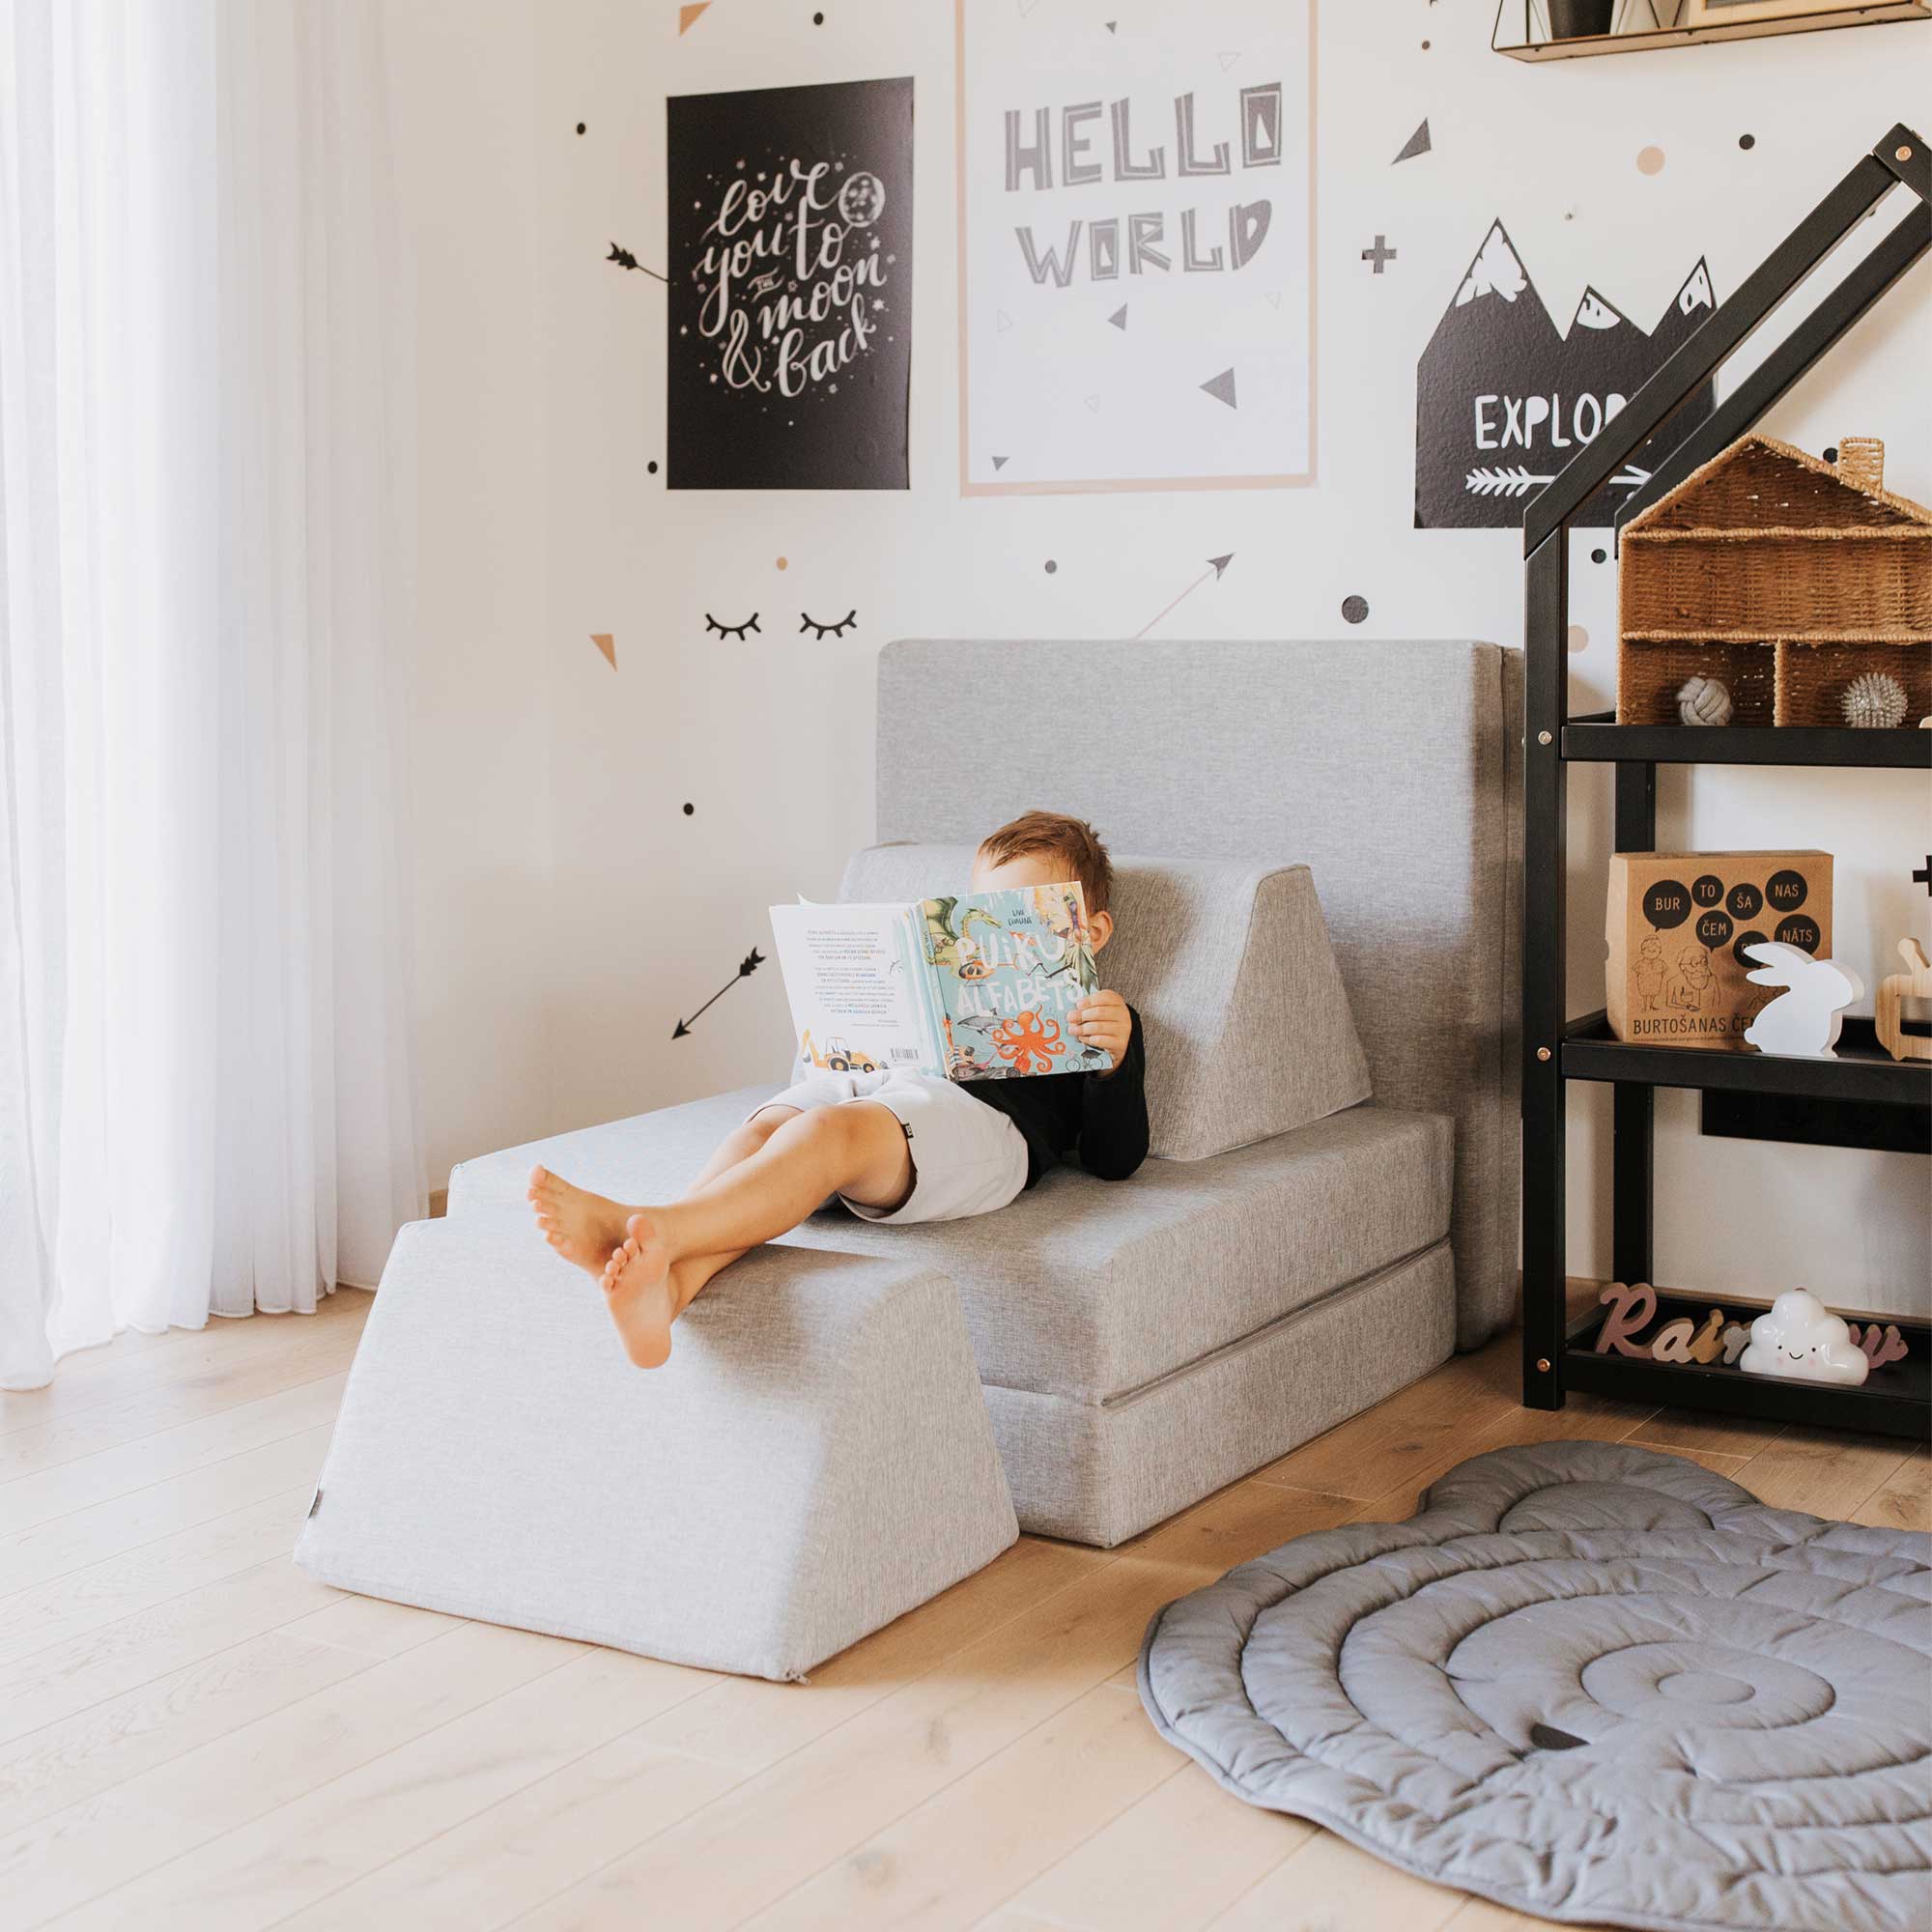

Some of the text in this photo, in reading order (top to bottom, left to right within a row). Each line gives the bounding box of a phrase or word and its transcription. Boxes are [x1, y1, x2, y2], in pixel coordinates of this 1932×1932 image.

[1005, 81, 1283, 192] HELLO
[702, 158, 840, 242] love
[692, 196, 850, 336] you to
[1014, 199, 1272, 288] WORLD
[757, 254, 887, 339] moon
[723, 293, 877, 397] & back
[1655, 884, 1800, 911] BUR TO ŠA NAS
[1701, 922, 1727, 936] ČEM
[1633, 1011, 1754, 1035] BURTOŠANAS ČE
